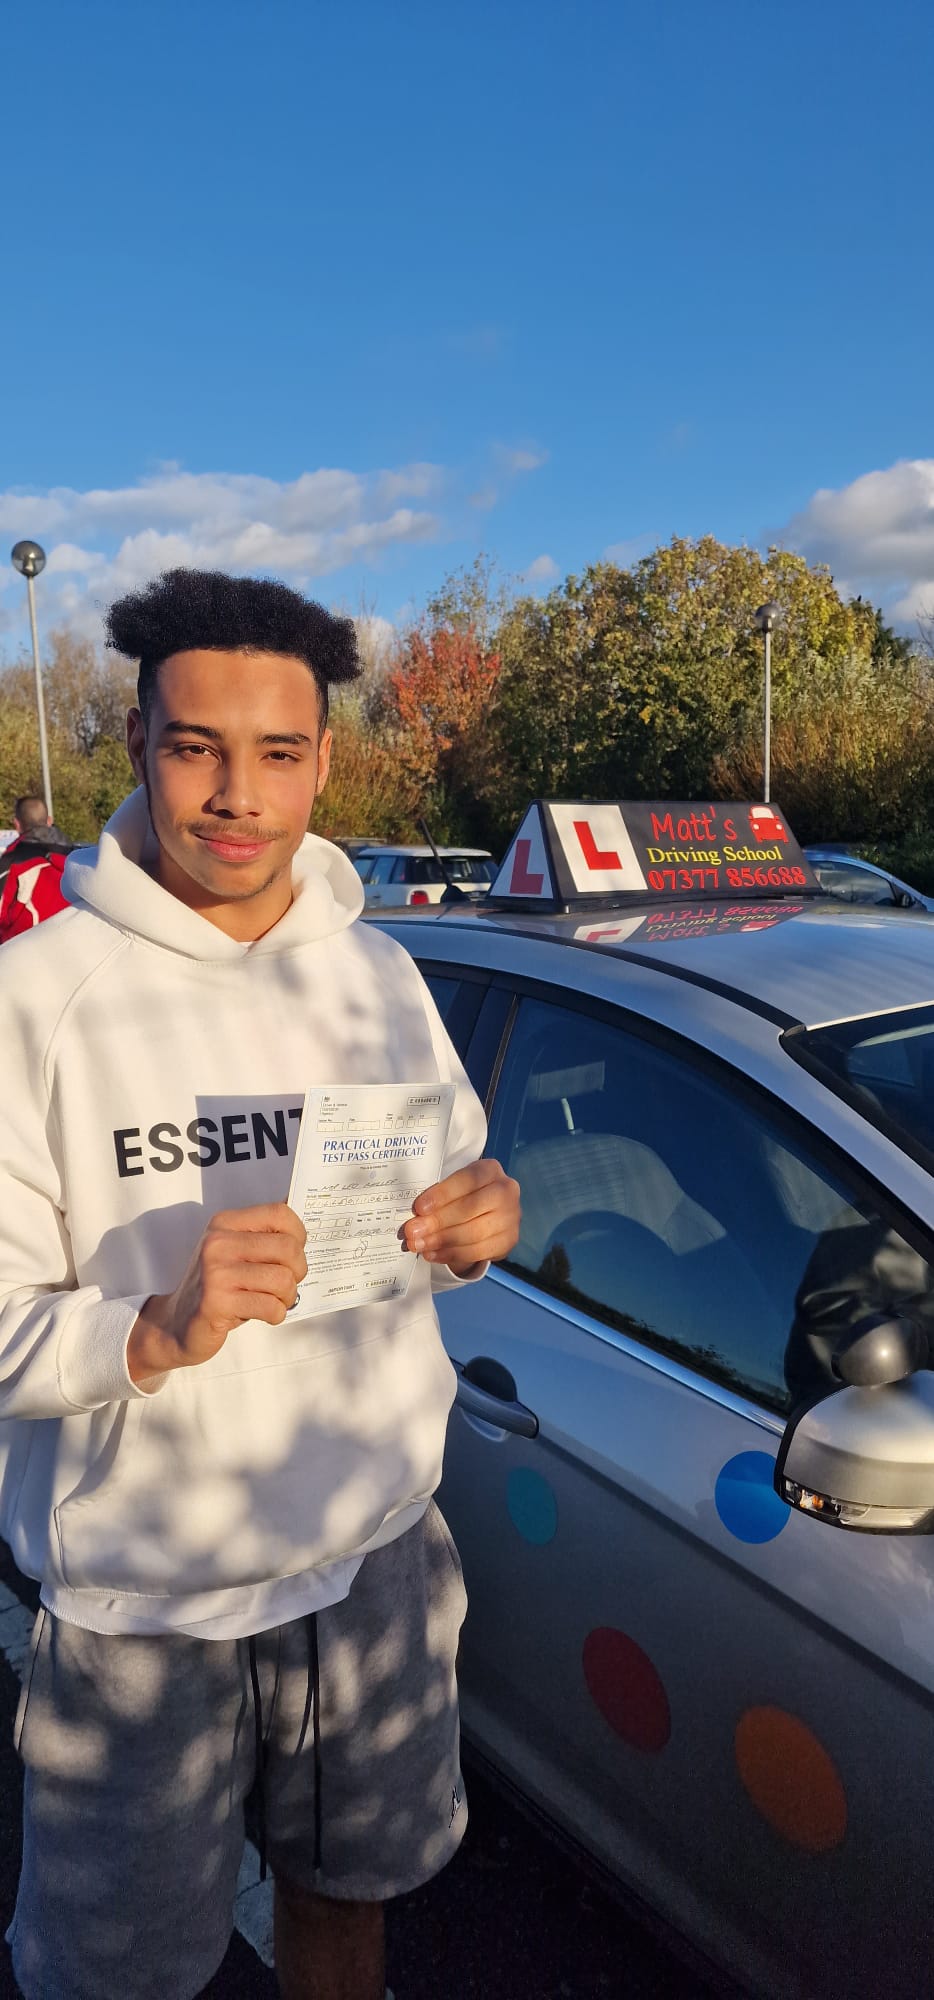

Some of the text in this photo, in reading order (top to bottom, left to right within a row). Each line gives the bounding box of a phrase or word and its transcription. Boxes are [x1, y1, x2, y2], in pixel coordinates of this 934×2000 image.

[650, 806, 738, 842] Matt's
[573, 821, 623, 870] L
[646, 845, 783, 866] Driving School
[509, 839, 545, 895] L
[647, 865, 807, 891] 07377 856688
[322, 1147, 426, 1163] TEST PASS CERTIFICATE
[323, 1135, 428, 1151] PRACTICAL DRIVING
